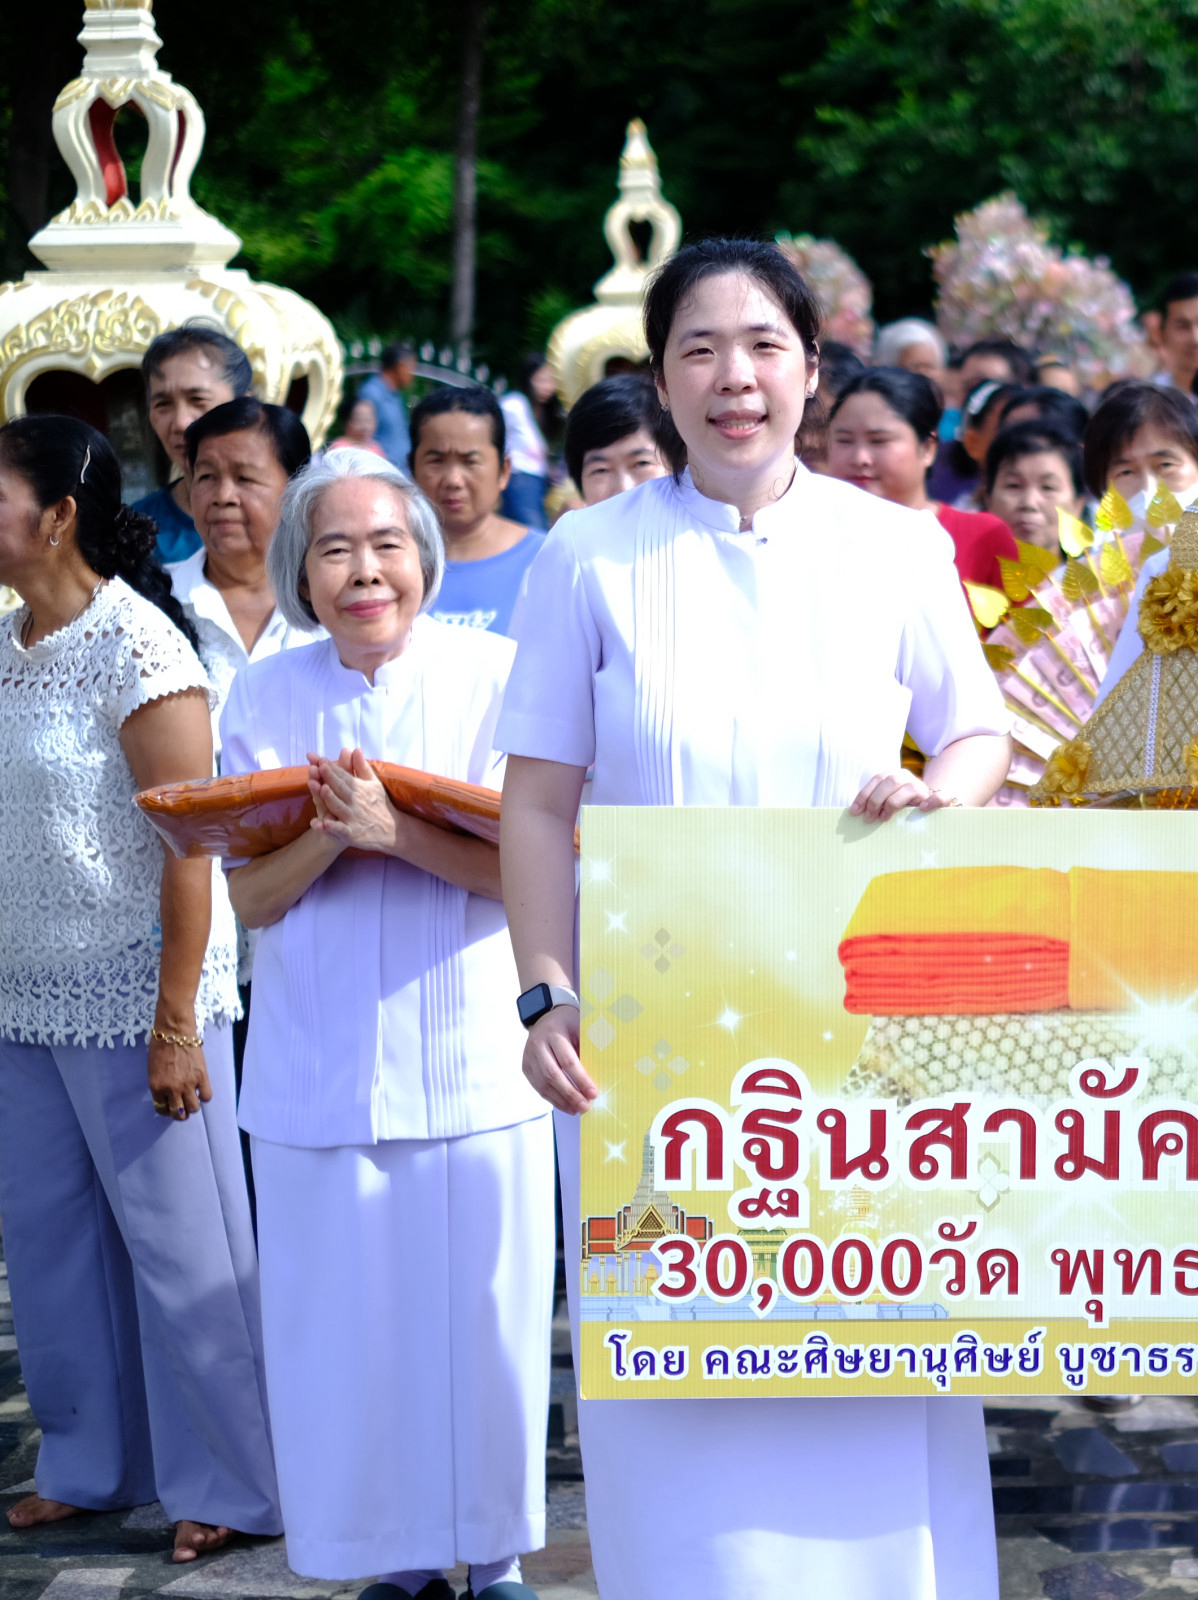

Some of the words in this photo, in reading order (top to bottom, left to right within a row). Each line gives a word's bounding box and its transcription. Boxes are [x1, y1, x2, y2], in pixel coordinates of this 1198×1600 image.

[607, 1332, 686, 1378] โดย
[705, 1329, 1042, 1389] คณะศิษยานุศิษย์
